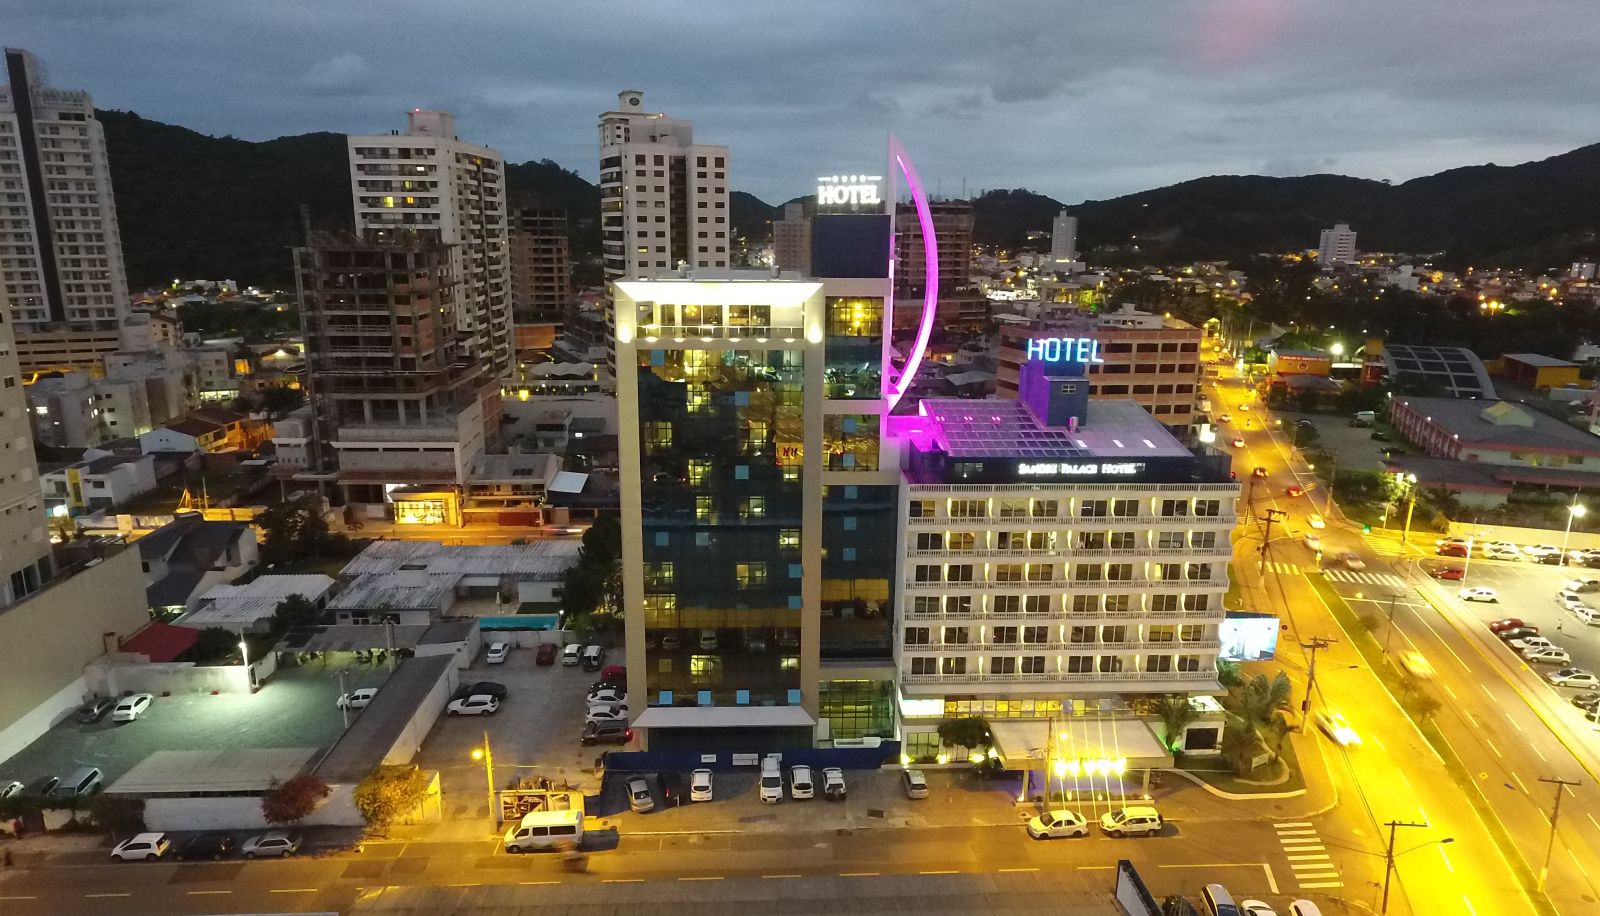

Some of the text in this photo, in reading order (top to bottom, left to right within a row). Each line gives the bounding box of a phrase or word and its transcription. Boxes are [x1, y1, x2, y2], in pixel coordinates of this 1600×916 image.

[818, 185, 880, 204] HOTEL
[1028, 338, 1104, 362] HOTEL
[1061, 463, 1098, 474] PALACE
[1101, 463, 1137, 474] HOTEL
